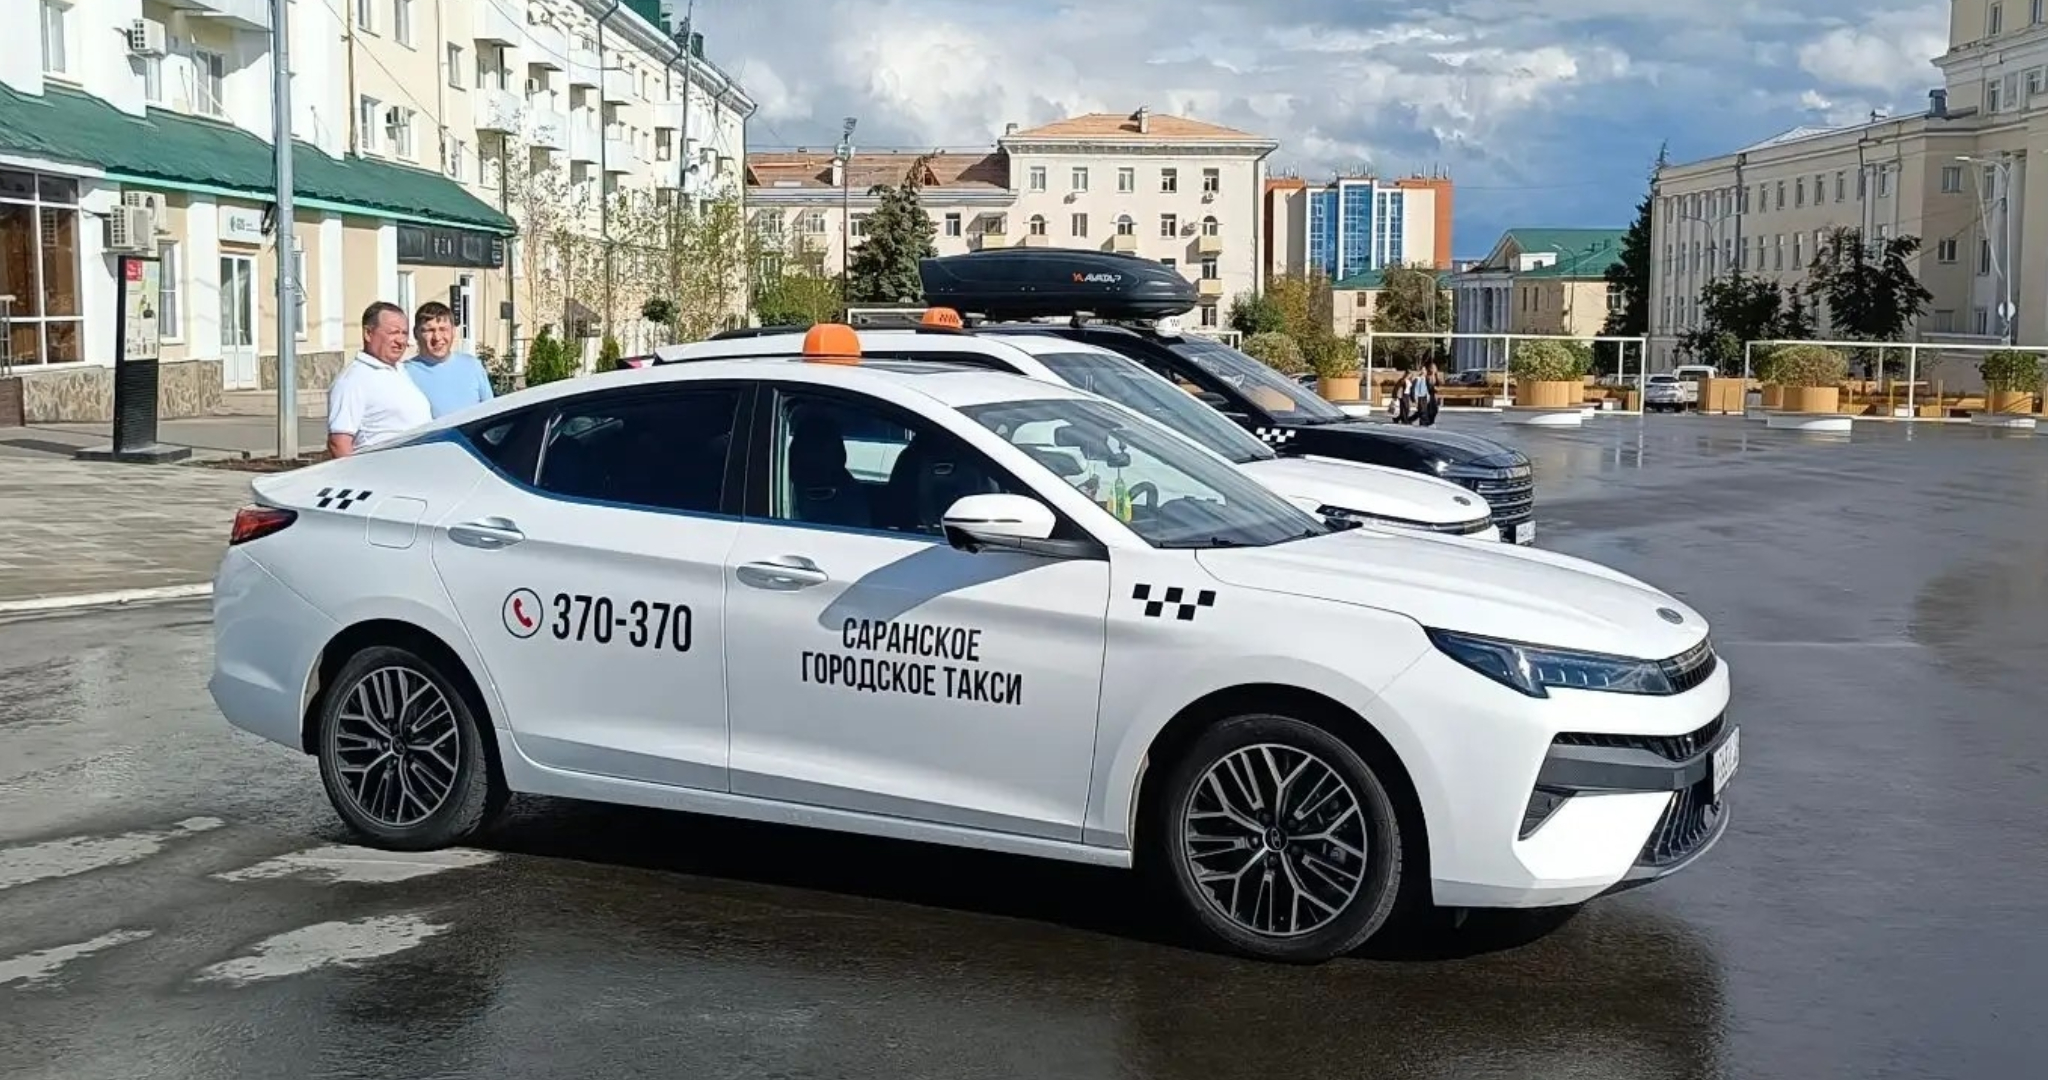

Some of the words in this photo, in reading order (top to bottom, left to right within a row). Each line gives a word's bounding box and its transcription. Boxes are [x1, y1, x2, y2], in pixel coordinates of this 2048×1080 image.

[551, 593, 693, 653] 370-370
[842, 617, 982, 662] САРАНСКОЕ
[802, 651, 936, 696] ГОРОДСКОЕ
[943, 666, 1023, 706] ТАКСИ
